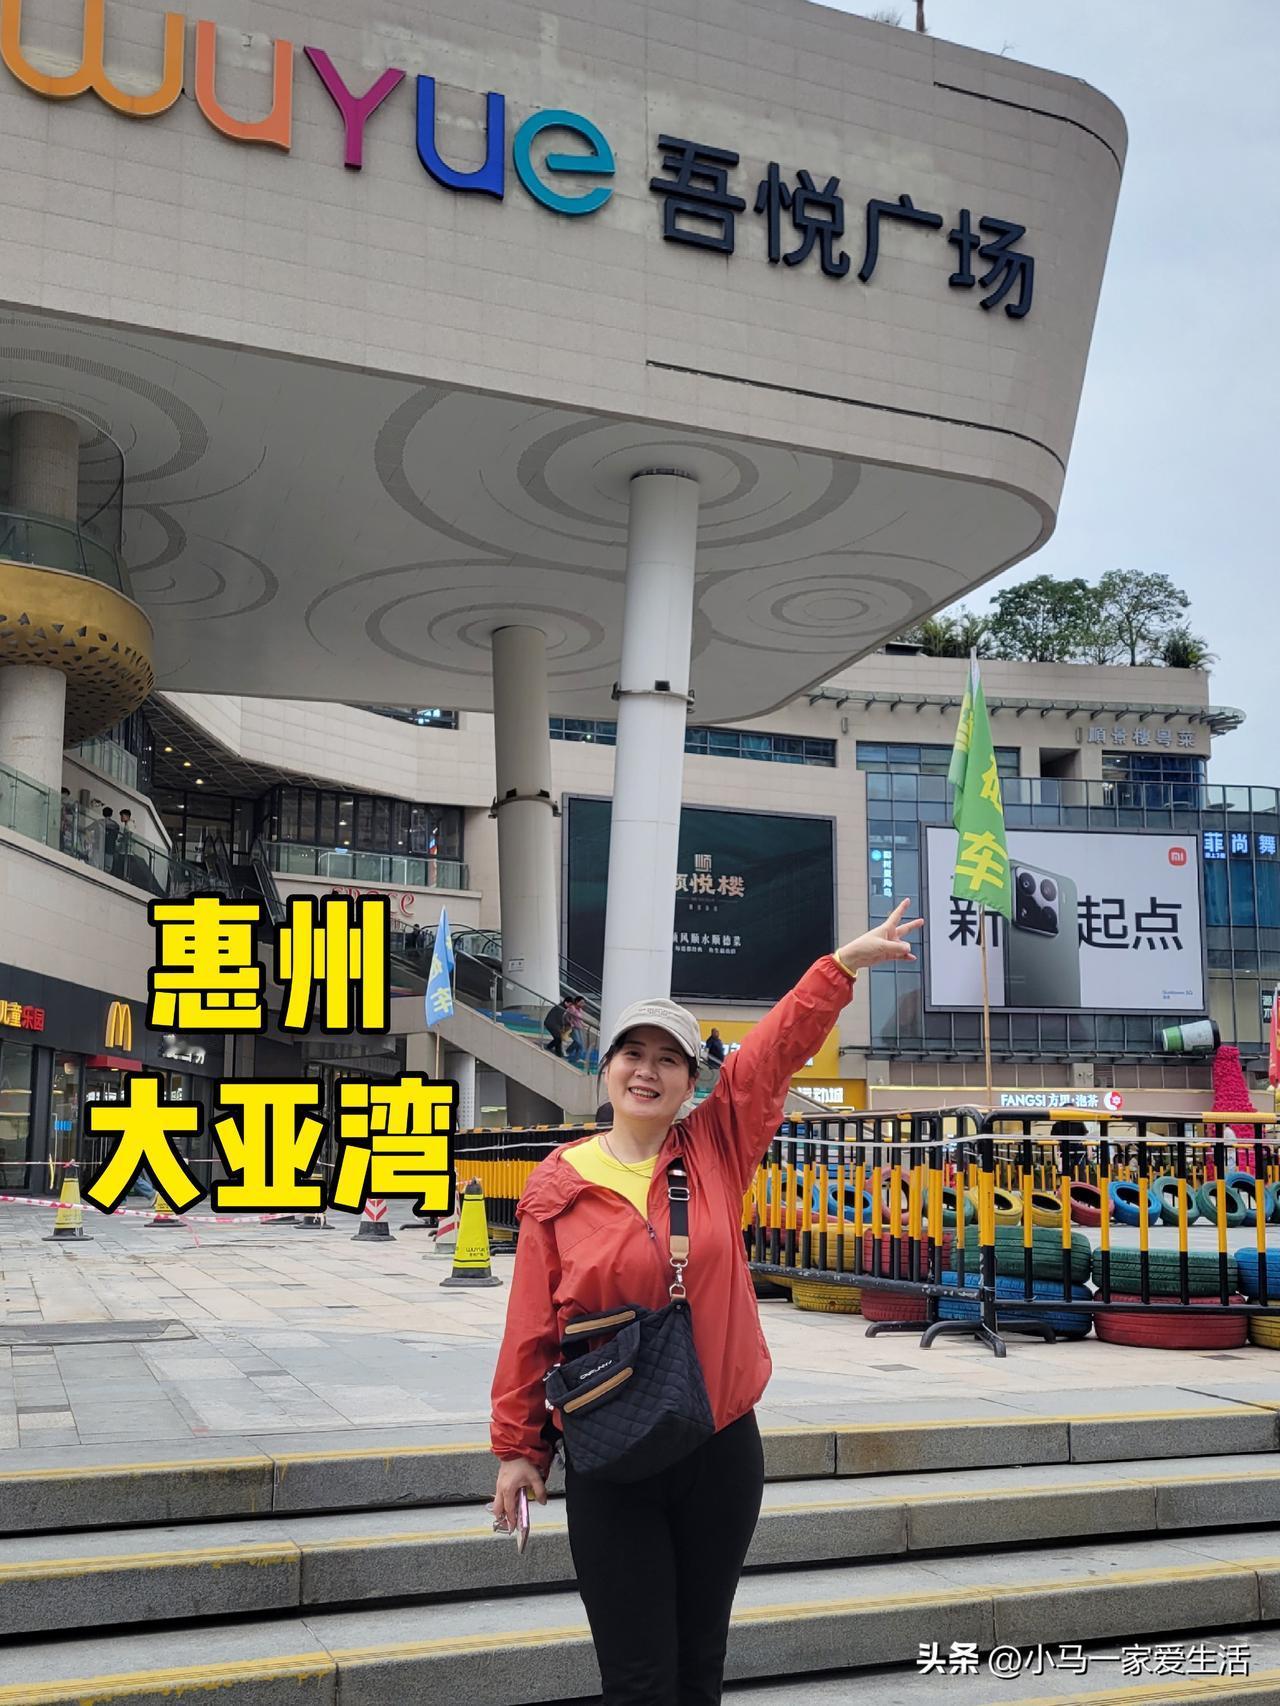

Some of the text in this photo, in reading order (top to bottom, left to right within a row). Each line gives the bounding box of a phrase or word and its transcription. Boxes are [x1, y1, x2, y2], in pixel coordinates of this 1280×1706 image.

[648, 133, 1036, 320] 吾悦广场
[1000, 1094, 1046, 1107] FANGSI
